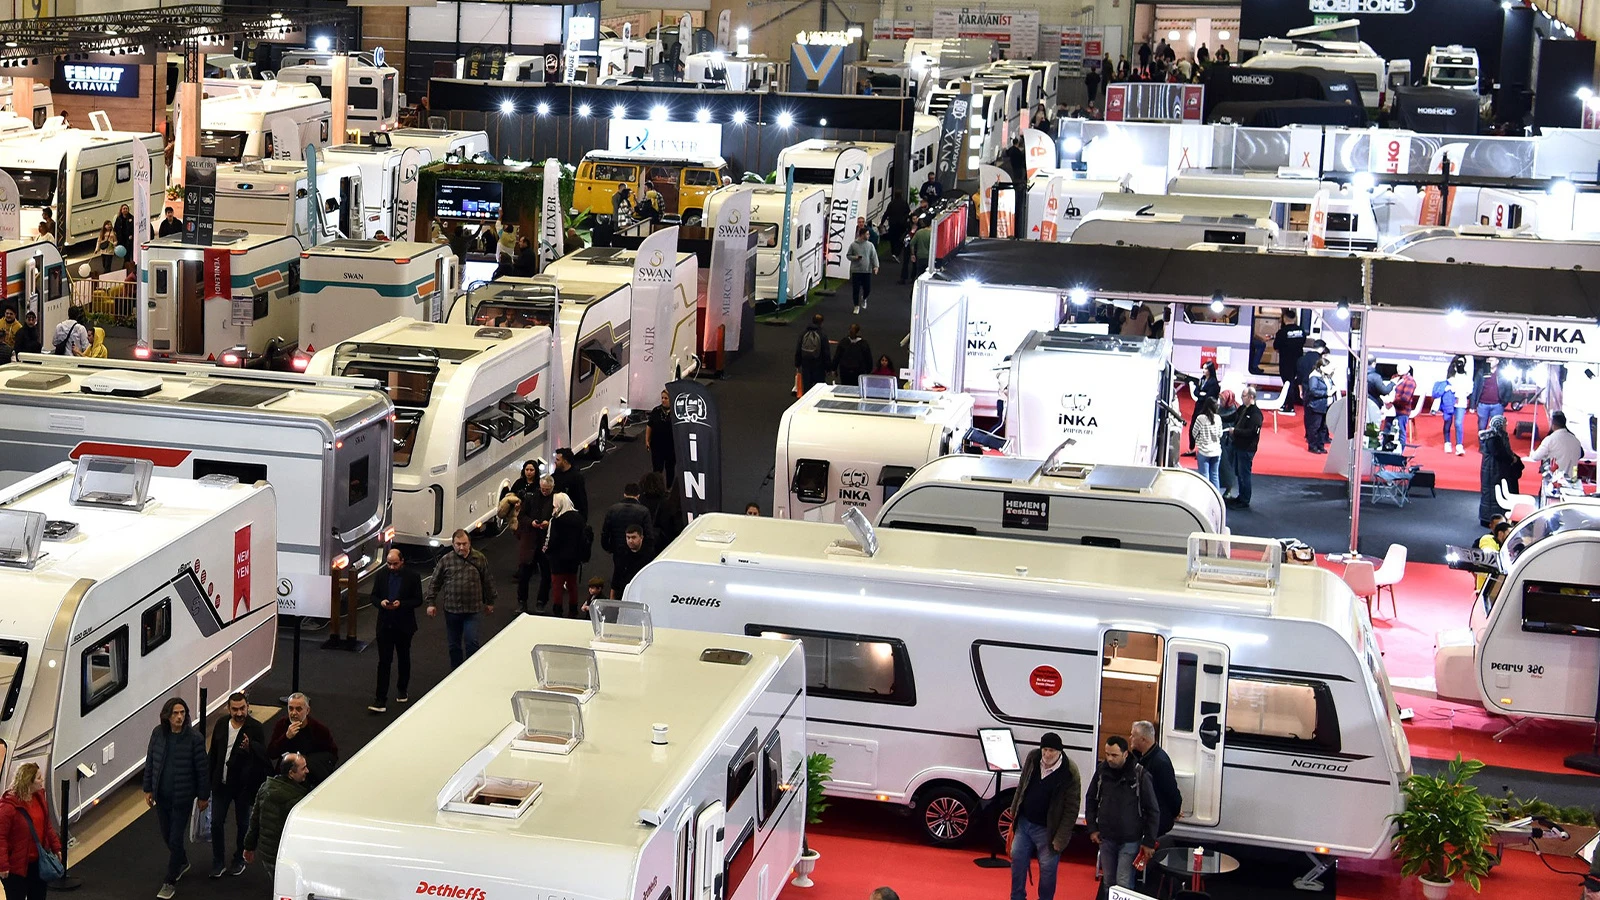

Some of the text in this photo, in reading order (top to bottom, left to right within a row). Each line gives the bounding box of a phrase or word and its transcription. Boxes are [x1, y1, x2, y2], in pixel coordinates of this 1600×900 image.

[64, 65, 125, 81] FENDT
[1232, 75, 1270, 85] MOBIHOME
[68, 81, 118, 92] CARAVAN
[1418, 107, 1452, 115] MOBIHOME
[940, 128, 956, 173] ONYX
[950, 130, 964, 173] KARAVAN
[546, 196, 556, 237] LUXER
[849, 200, 859, 219] van
[718, 226, 747, 235] SWAN
[827, 198, 849, 267] LUXER
[343, 272, 364, 280] SWAN
[638, 267, 673, 279] SWAN
[722, 268, 734, 316] MERCAN
[643, 326, 656, 362] SAFİR
[1006, 508, 1039, 517] Teslim
[236, 549, 250, 564] NEW
[670, 594, 721, 608] Dethleffs
[1527, 664, 1545, 675] 380
[1291, 759, 1348, 773] Nomad
[416, 881, 487, 900] Dethleffs
